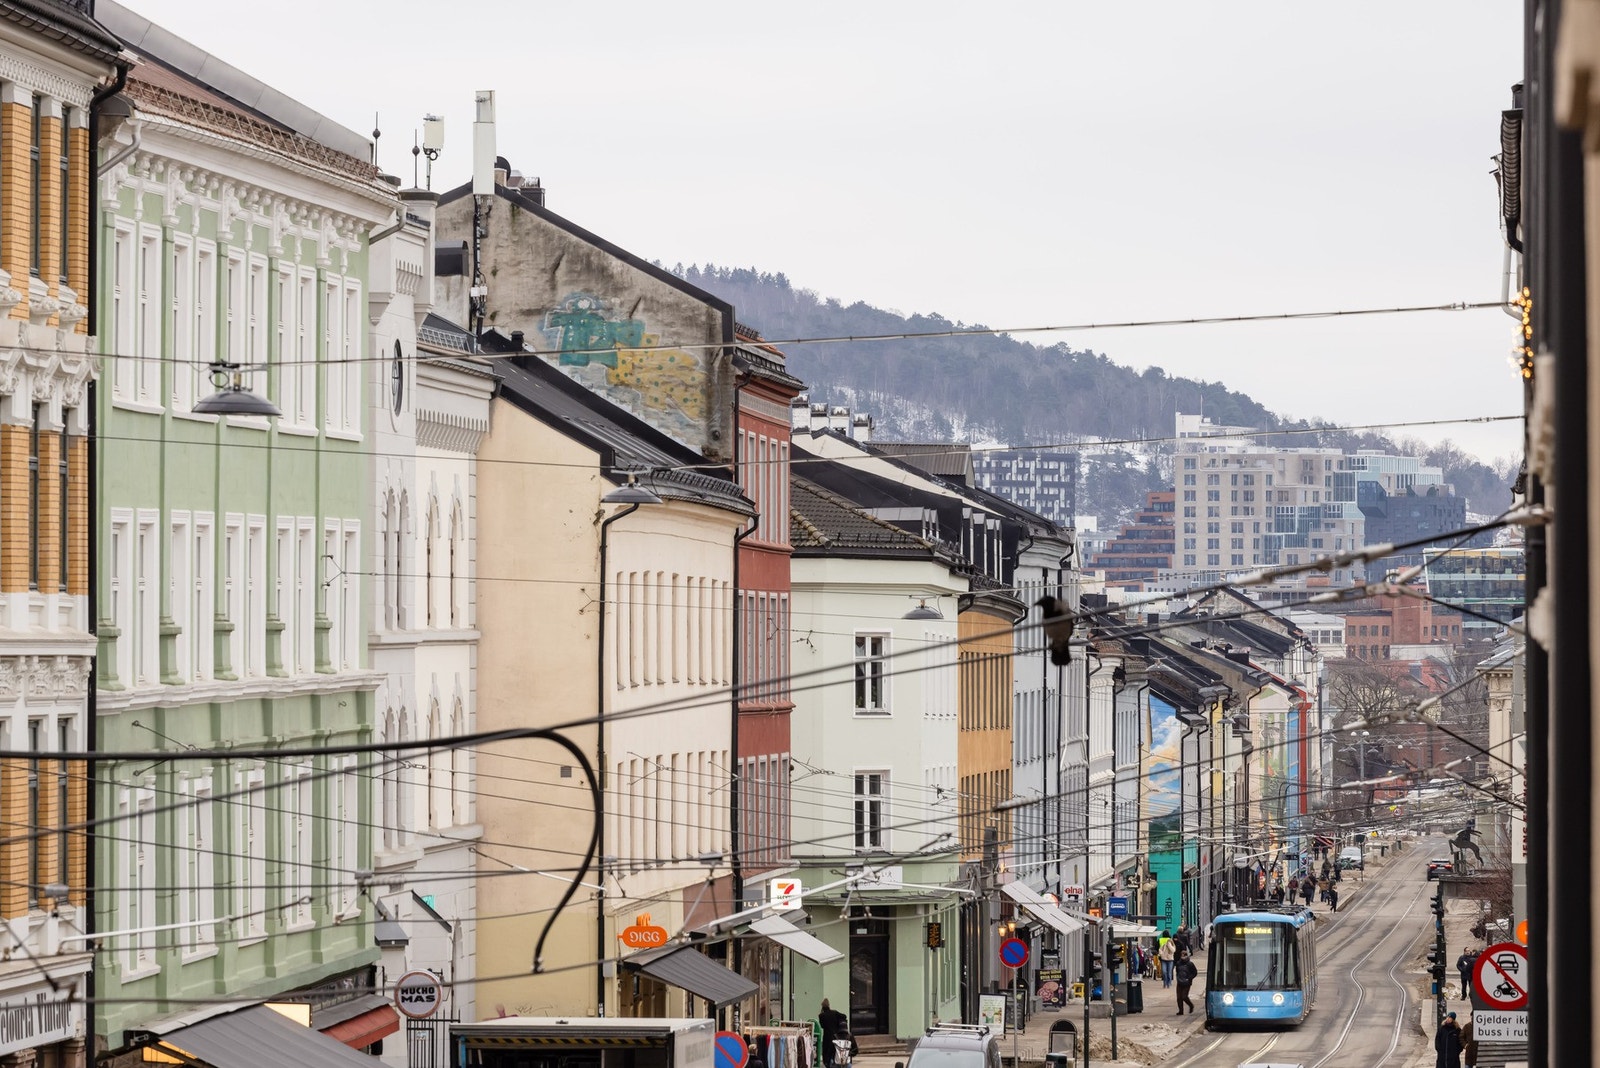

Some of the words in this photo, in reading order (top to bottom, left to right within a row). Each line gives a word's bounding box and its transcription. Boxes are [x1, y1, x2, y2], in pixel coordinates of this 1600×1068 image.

[1064, 886, 1083, 895] elna
[629, 931, 660, 943] DIGG
[401, 986, 435, 995] MUCHO
[401, 995, 436, 1003] MAS
[1246, 995, 1261, 1003] 403
[0, 997, 34, 1045] elouria
[37, 992, 72, 1035] Vintage
[1476, 1014, 1513, 1026] Gjelder
[1478, 1027, 1502, 1037] buss
[1506, 1027, 1510, 1036] i
